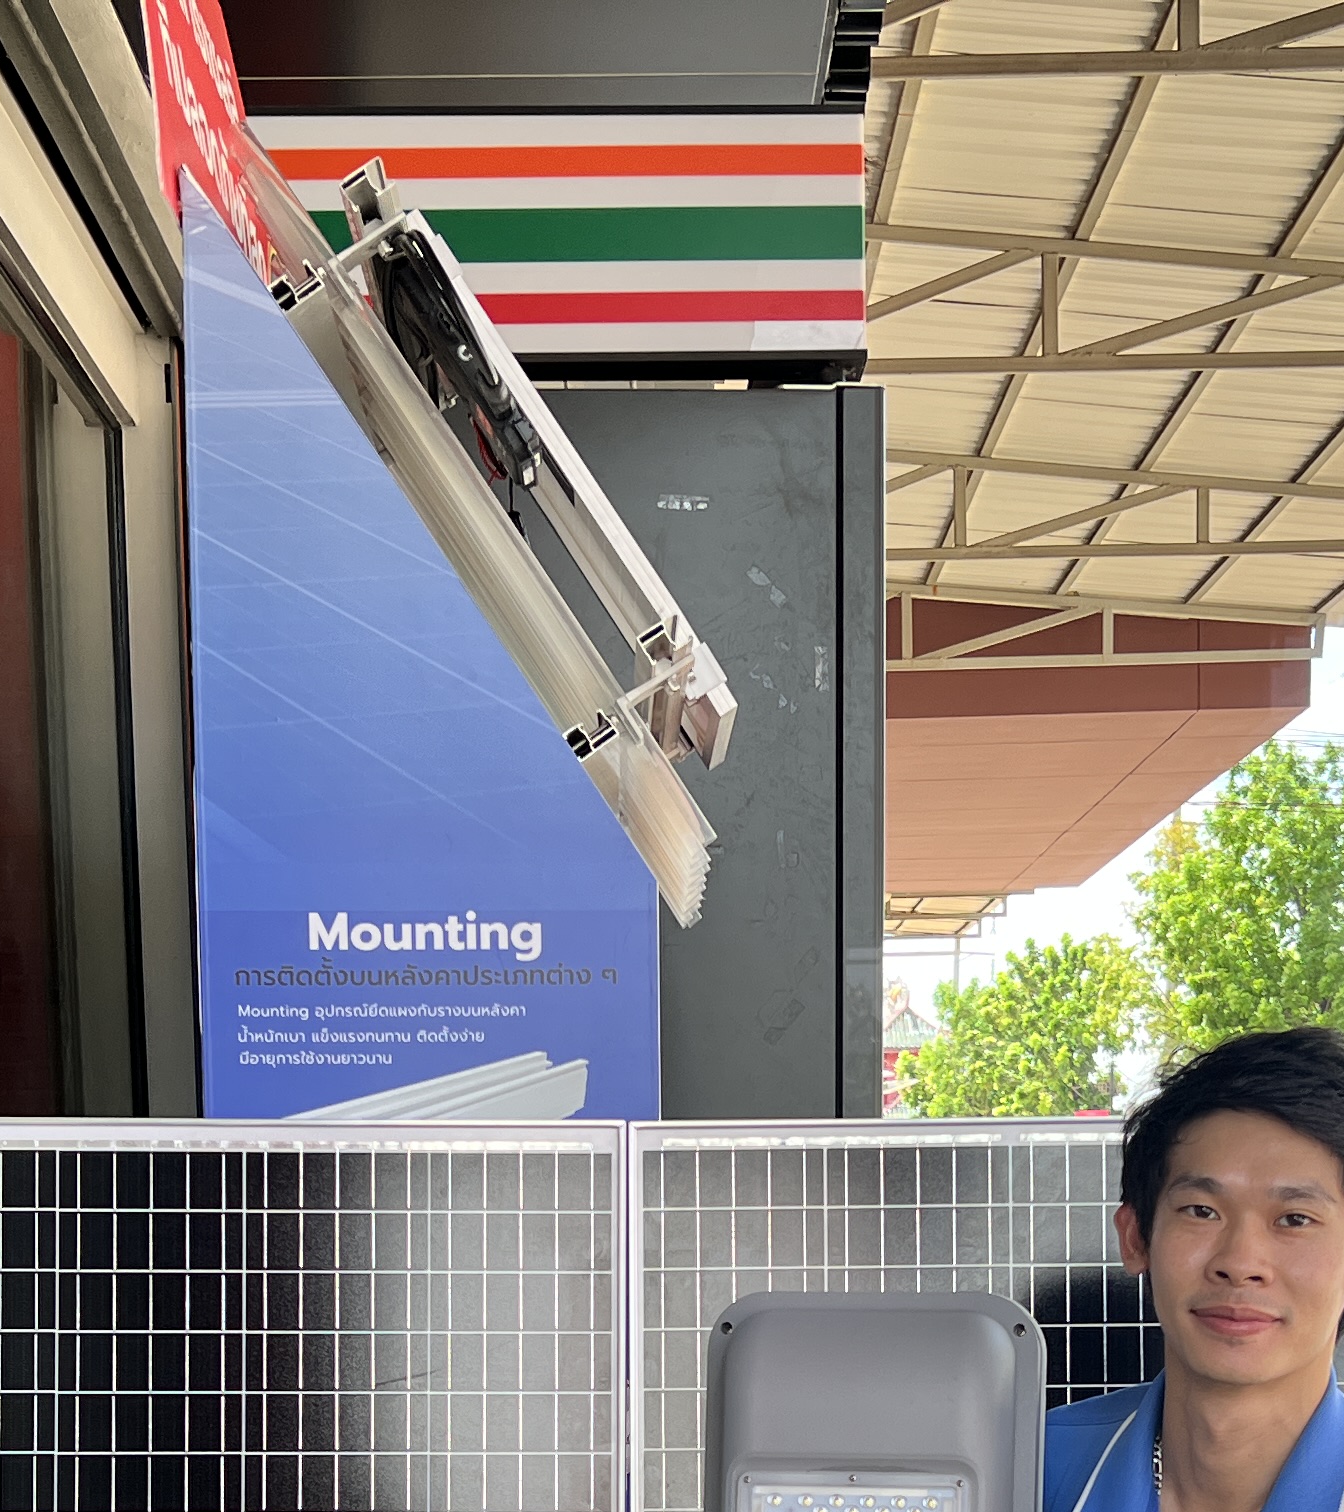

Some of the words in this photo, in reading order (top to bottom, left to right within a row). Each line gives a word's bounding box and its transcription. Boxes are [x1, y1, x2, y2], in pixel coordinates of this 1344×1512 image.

[308, 910, 543, 961] Mounting
[235, 956, 592, 986] การติดตั้งบนหลังคาประเภทต่าง
[601, 968, 618, 985] ๆ
[238, 1004, 309, 1020] Mounting
[314, 1003, 526, 1021] อุปกรณ์ยึดแผงกับรางบนหลังคา
[237, 1025, 306, 1043] น้ำหนักเบา
[311, 1028, 410, 1043] แข็งแรงทนทาน
[417, 1026, 485, 1043] ติดตั้งง่าย
[239, 1051, 393, 1068] มีอายุการใช้งานยาวนาน
